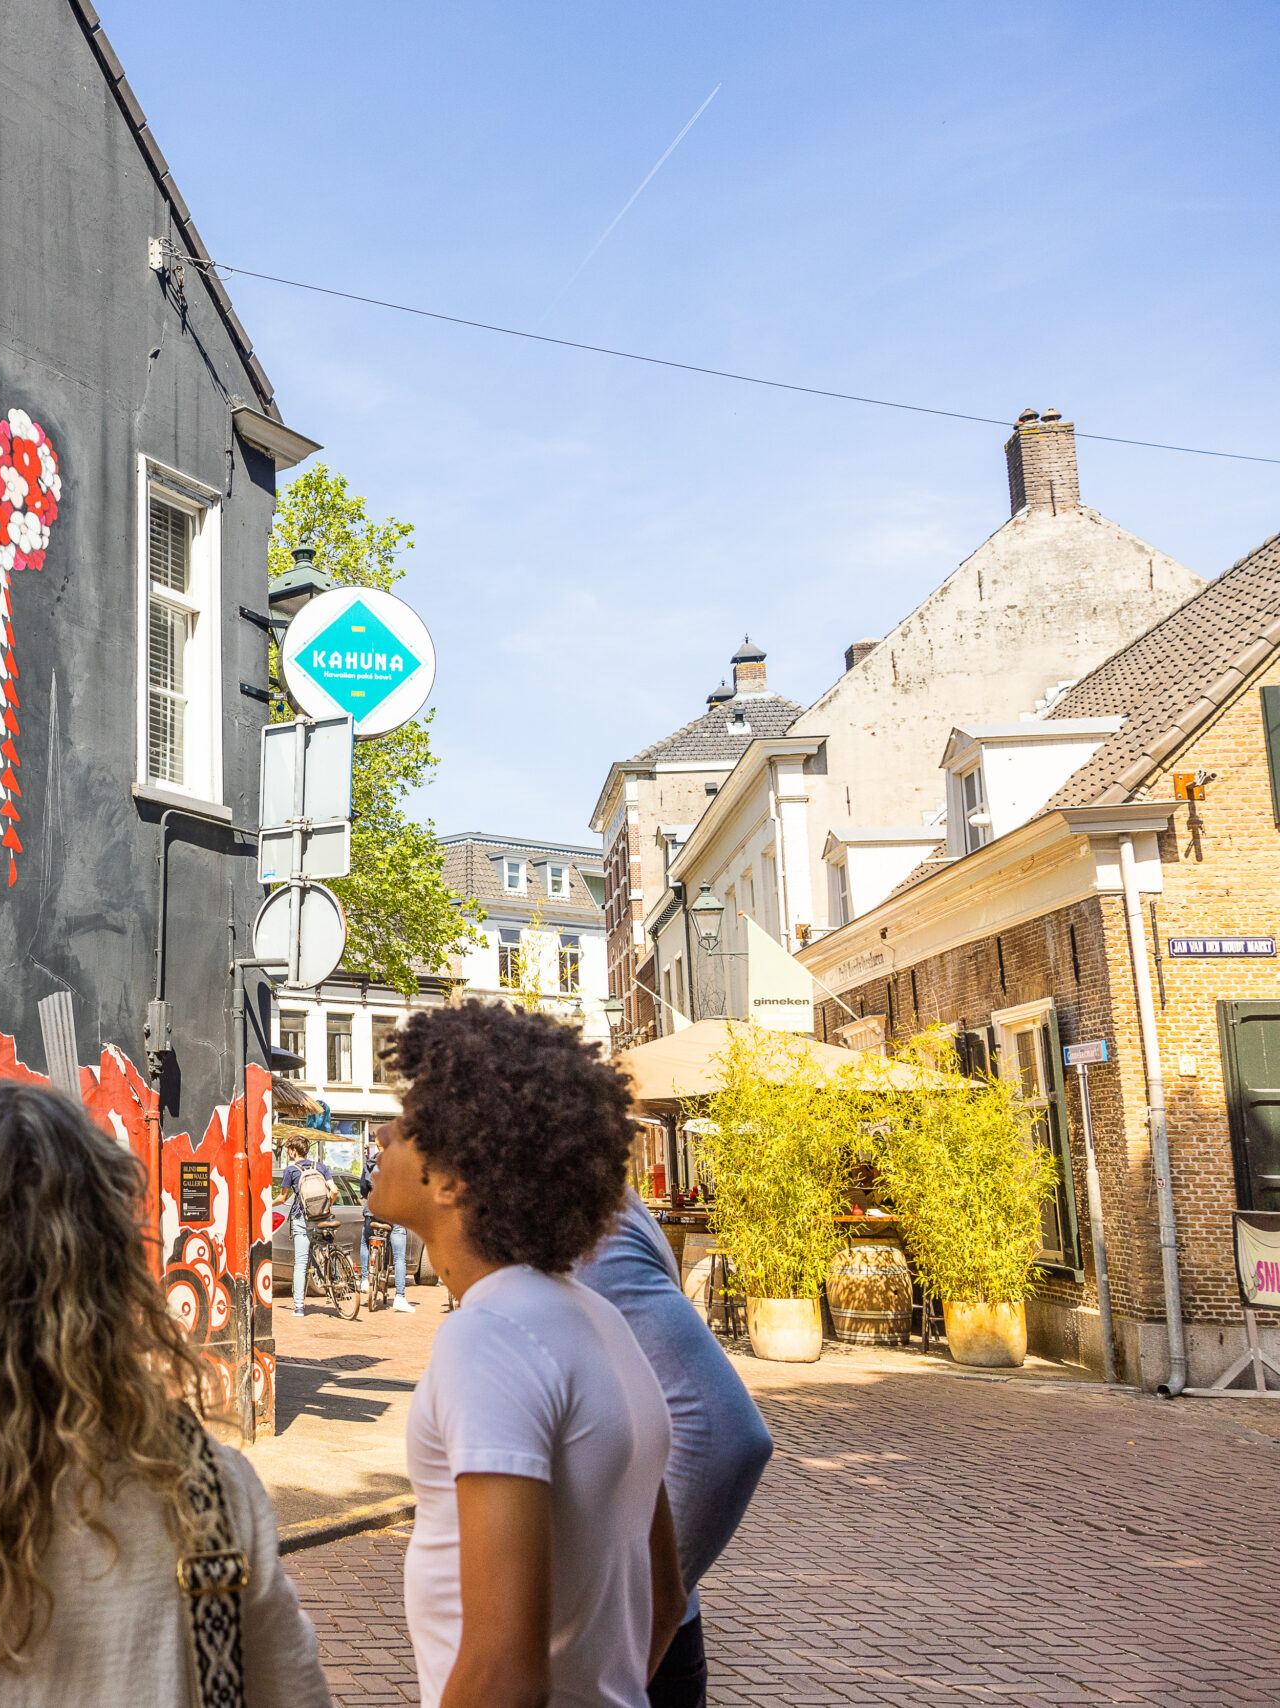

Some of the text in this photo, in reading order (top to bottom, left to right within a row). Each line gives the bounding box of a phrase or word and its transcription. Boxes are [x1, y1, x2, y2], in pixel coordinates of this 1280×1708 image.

[313, 650, 403, 672] KAHUNA
[324, 671, 356, 679] Hawaiian
[374, 673, 392, 681] bowl
[753, 997, 810, 1007] ginneken
